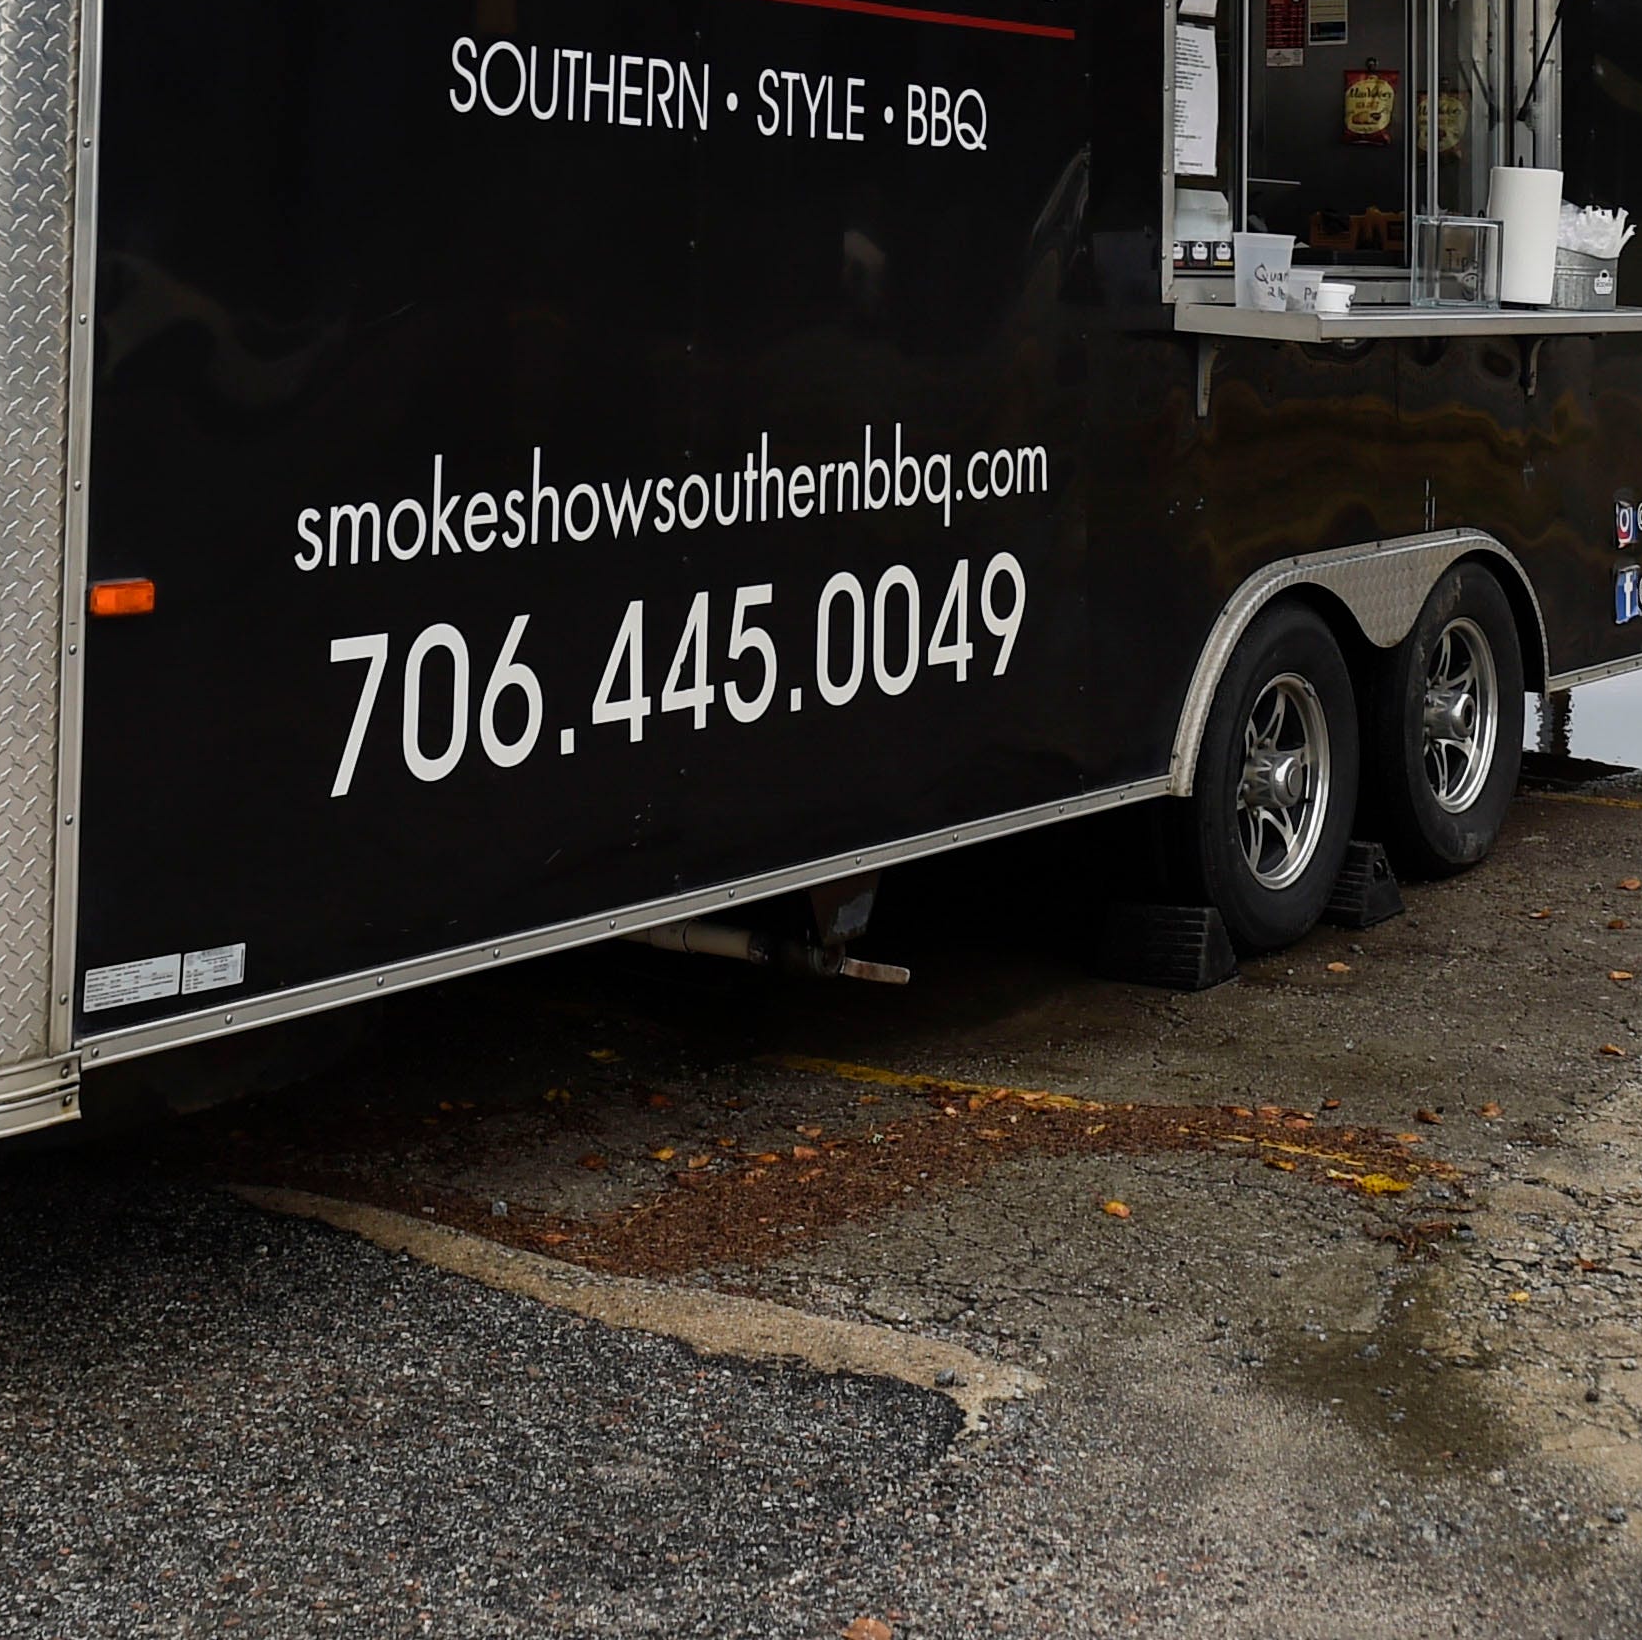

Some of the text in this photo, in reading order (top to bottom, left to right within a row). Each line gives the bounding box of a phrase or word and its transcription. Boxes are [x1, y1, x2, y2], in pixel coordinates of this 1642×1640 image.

[449, 36, 988, 151] SOUTHERN STYLE BBQ
[1254, 262, 1289, 285] Quar
[294, 423, 1049, 572] smokeshowsouthernbbq.com
[329, 551, 1028, 798] 706.445.0049
